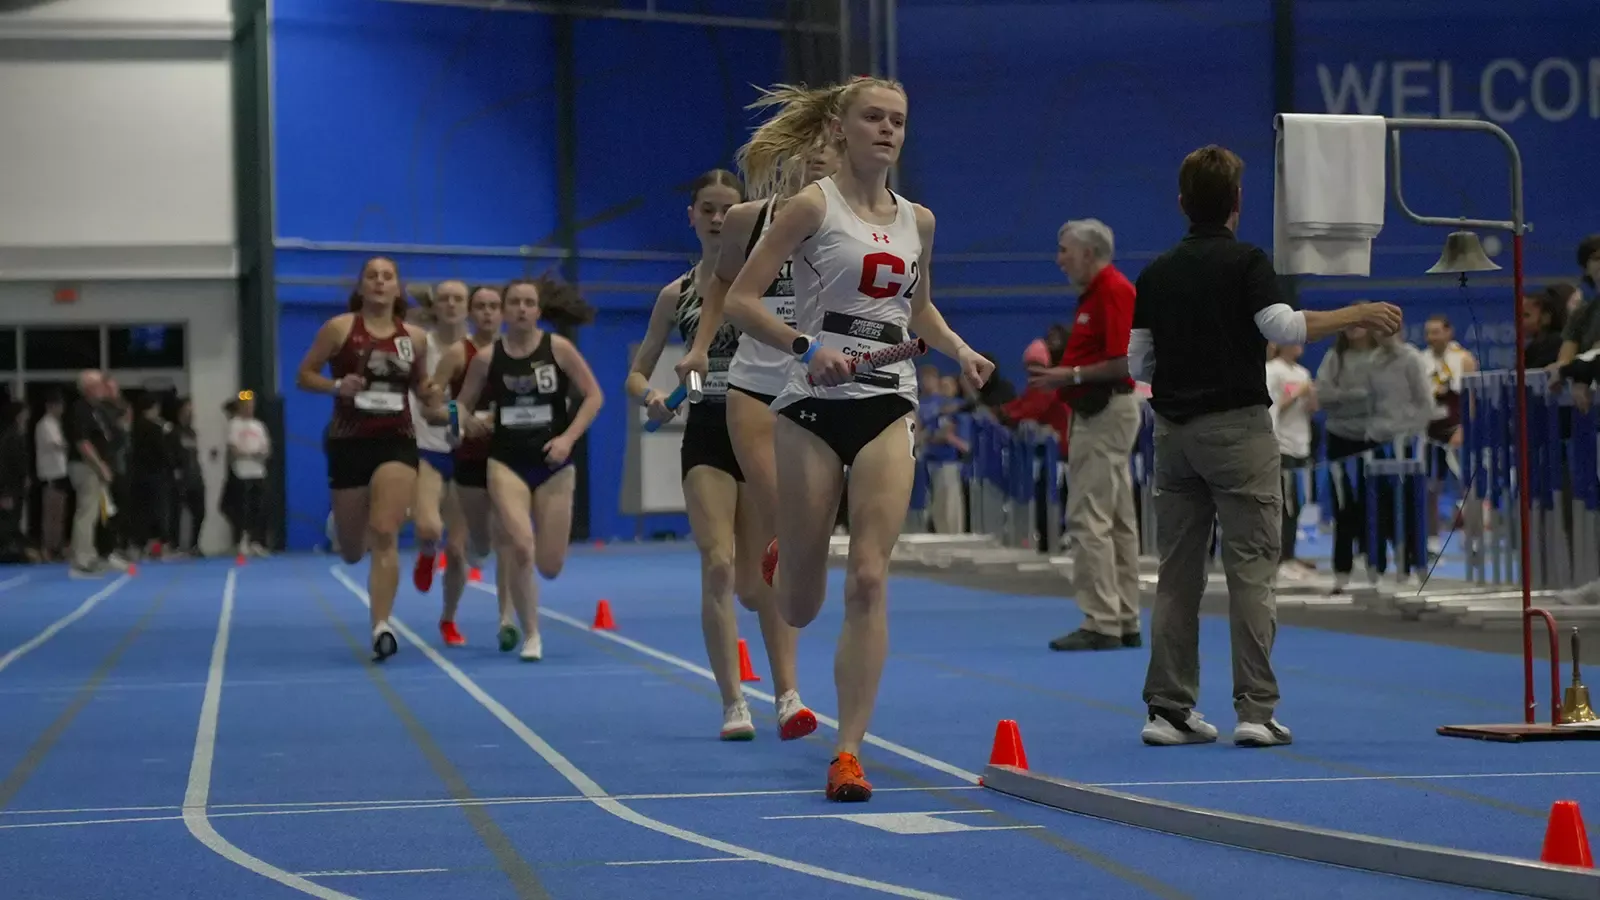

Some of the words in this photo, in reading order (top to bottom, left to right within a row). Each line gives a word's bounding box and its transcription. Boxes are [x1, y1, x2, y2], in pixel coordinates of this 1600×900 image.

[857, 251, 906, 299] C
[902, 260, 919, 299] 2
[842, 346, 867, 358] Cor
[540, 367, 553, 390] 5
